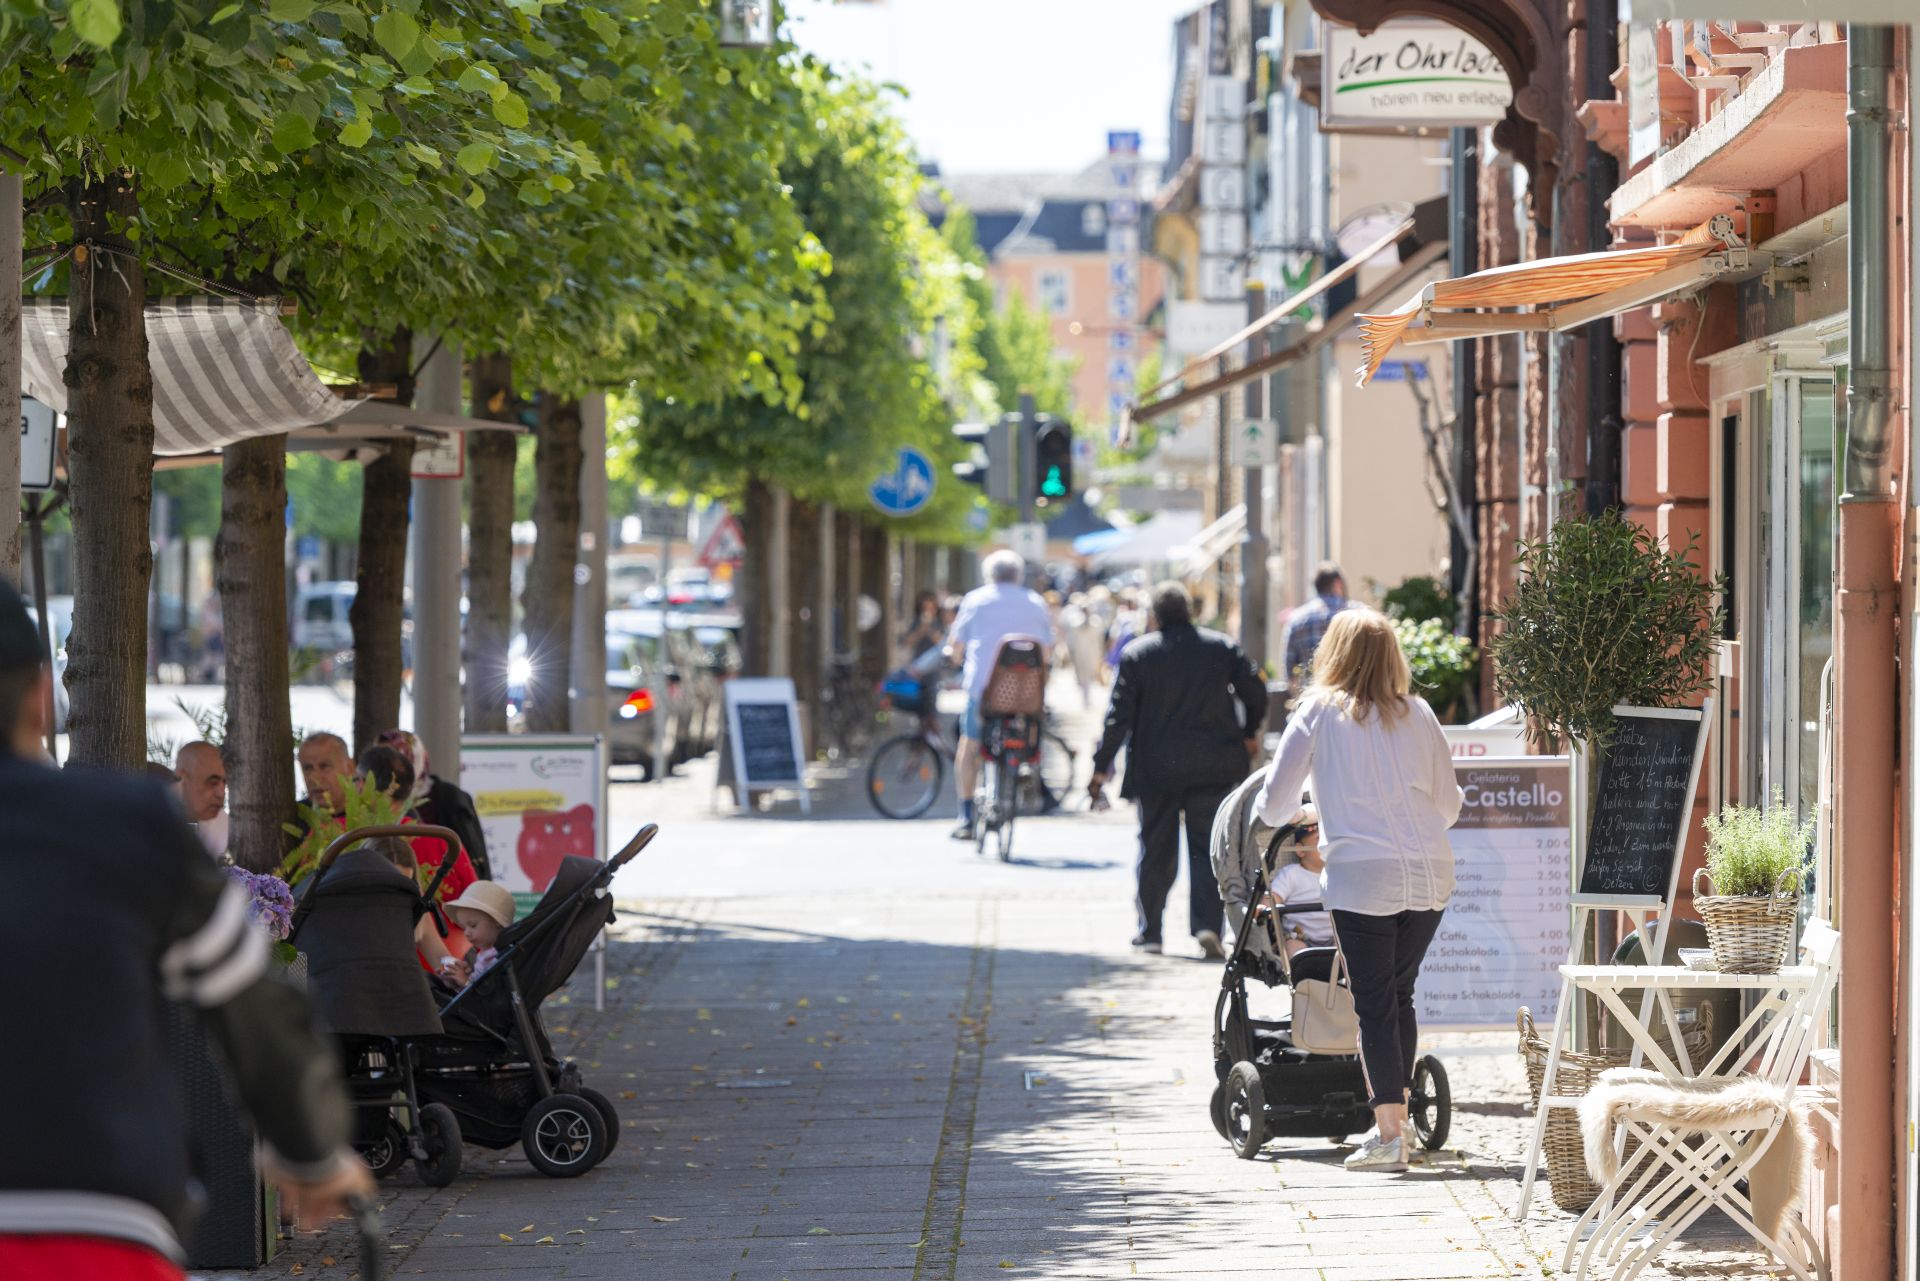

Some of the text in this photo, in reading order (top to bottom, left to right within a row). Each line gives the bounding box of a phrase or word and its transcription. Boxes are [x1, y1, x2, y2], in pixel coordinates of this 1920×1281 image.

[1338, 46, 1390, 79] der
[1423, 91, 1454, 105] neu
[1614, 721, 1647, 746] Liebe
[1467, 771, 1520, 784] Gelateria
[1463, 783, 1562, 807] Castello
[1636, 794, 1661, 809] und
[1440, 946, 1500, 957] Schokolade
[1424, 962, 1481, 973] Milchshake
[1424, 991, 1458, 1000] Heisse
[1461, 989, 1520, 1000] Schokolade
[1425, 1006, 1442, 1016] Tee
